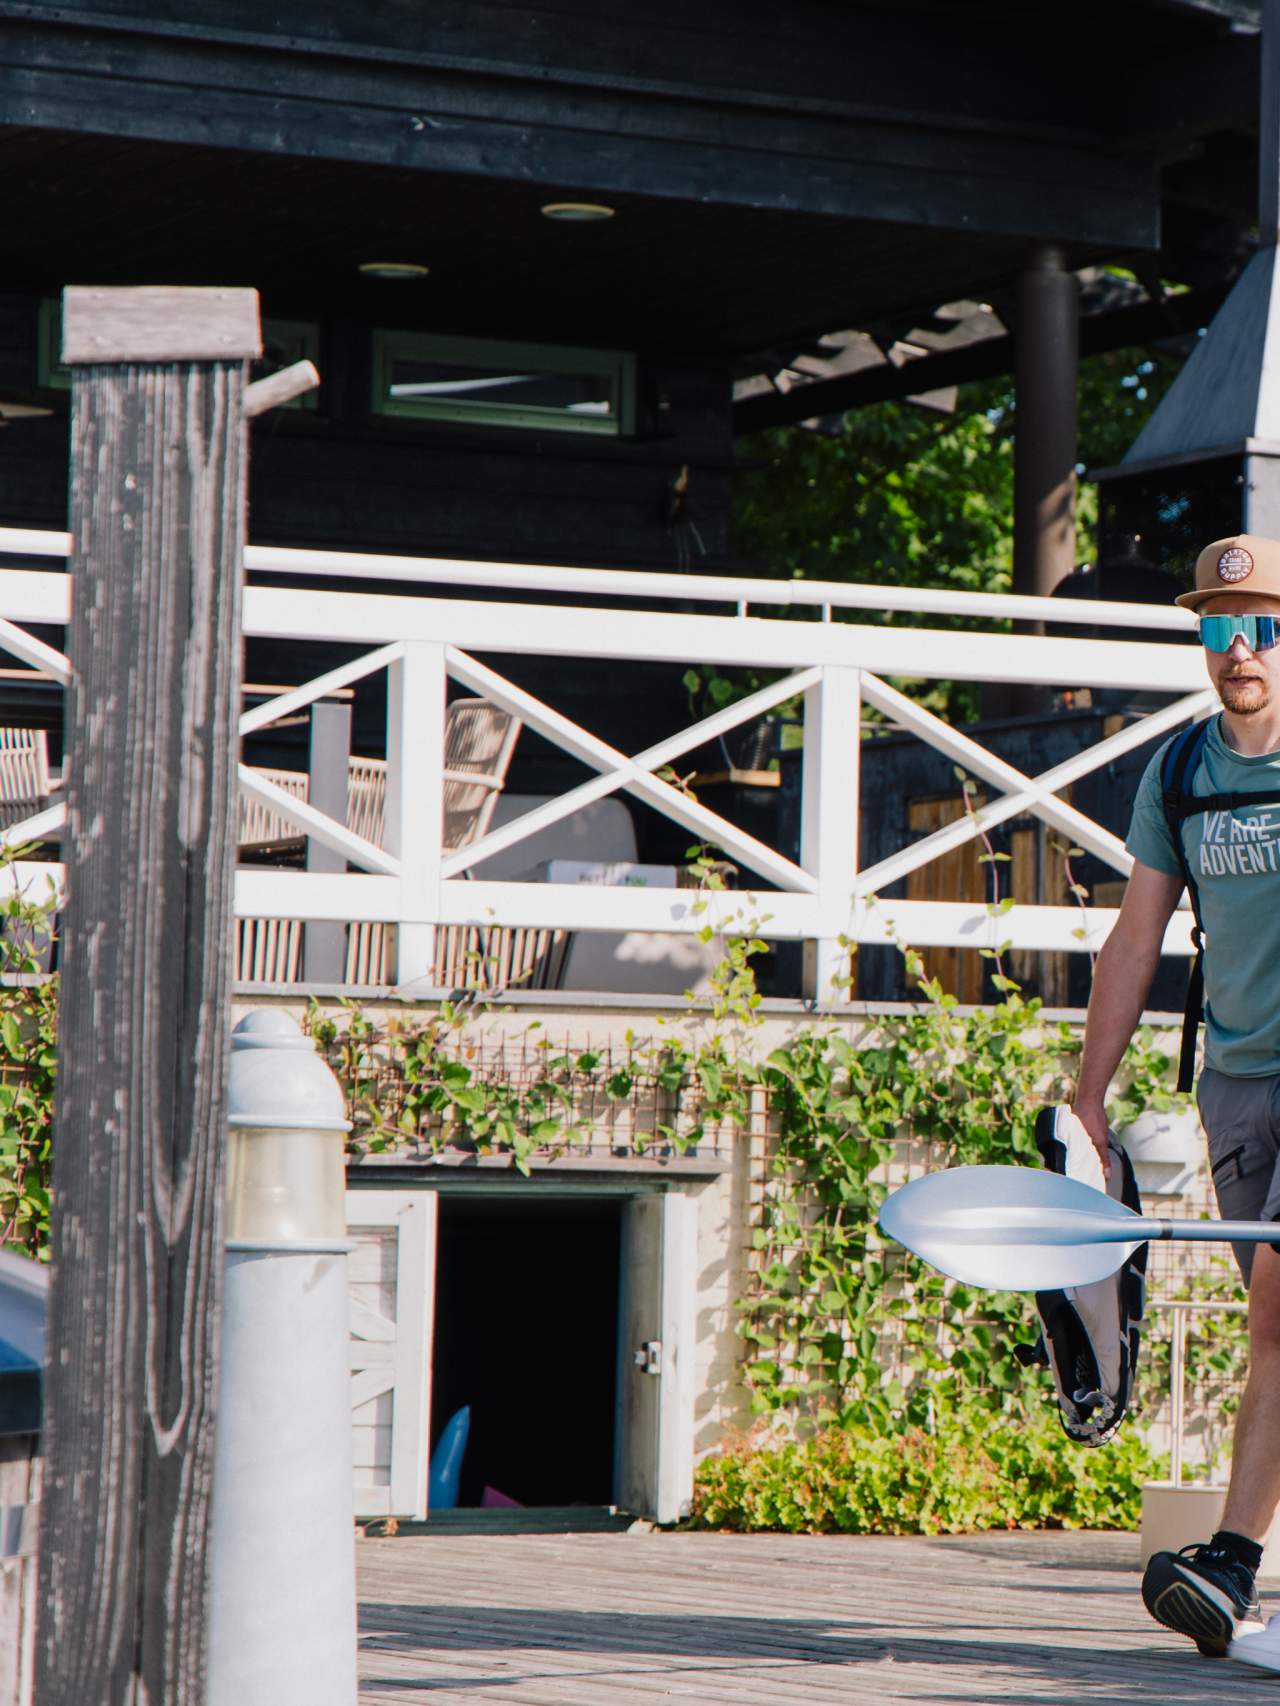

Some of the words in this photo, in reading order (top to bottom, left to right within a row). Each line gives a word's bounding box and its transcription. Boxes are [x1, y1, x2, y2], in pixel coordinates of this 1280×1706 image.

[1220, 567, 1248, 580] SUPPLY
[1203, 810, 1230, 842] WE
[1231, 814, 1272, 843] ARE
